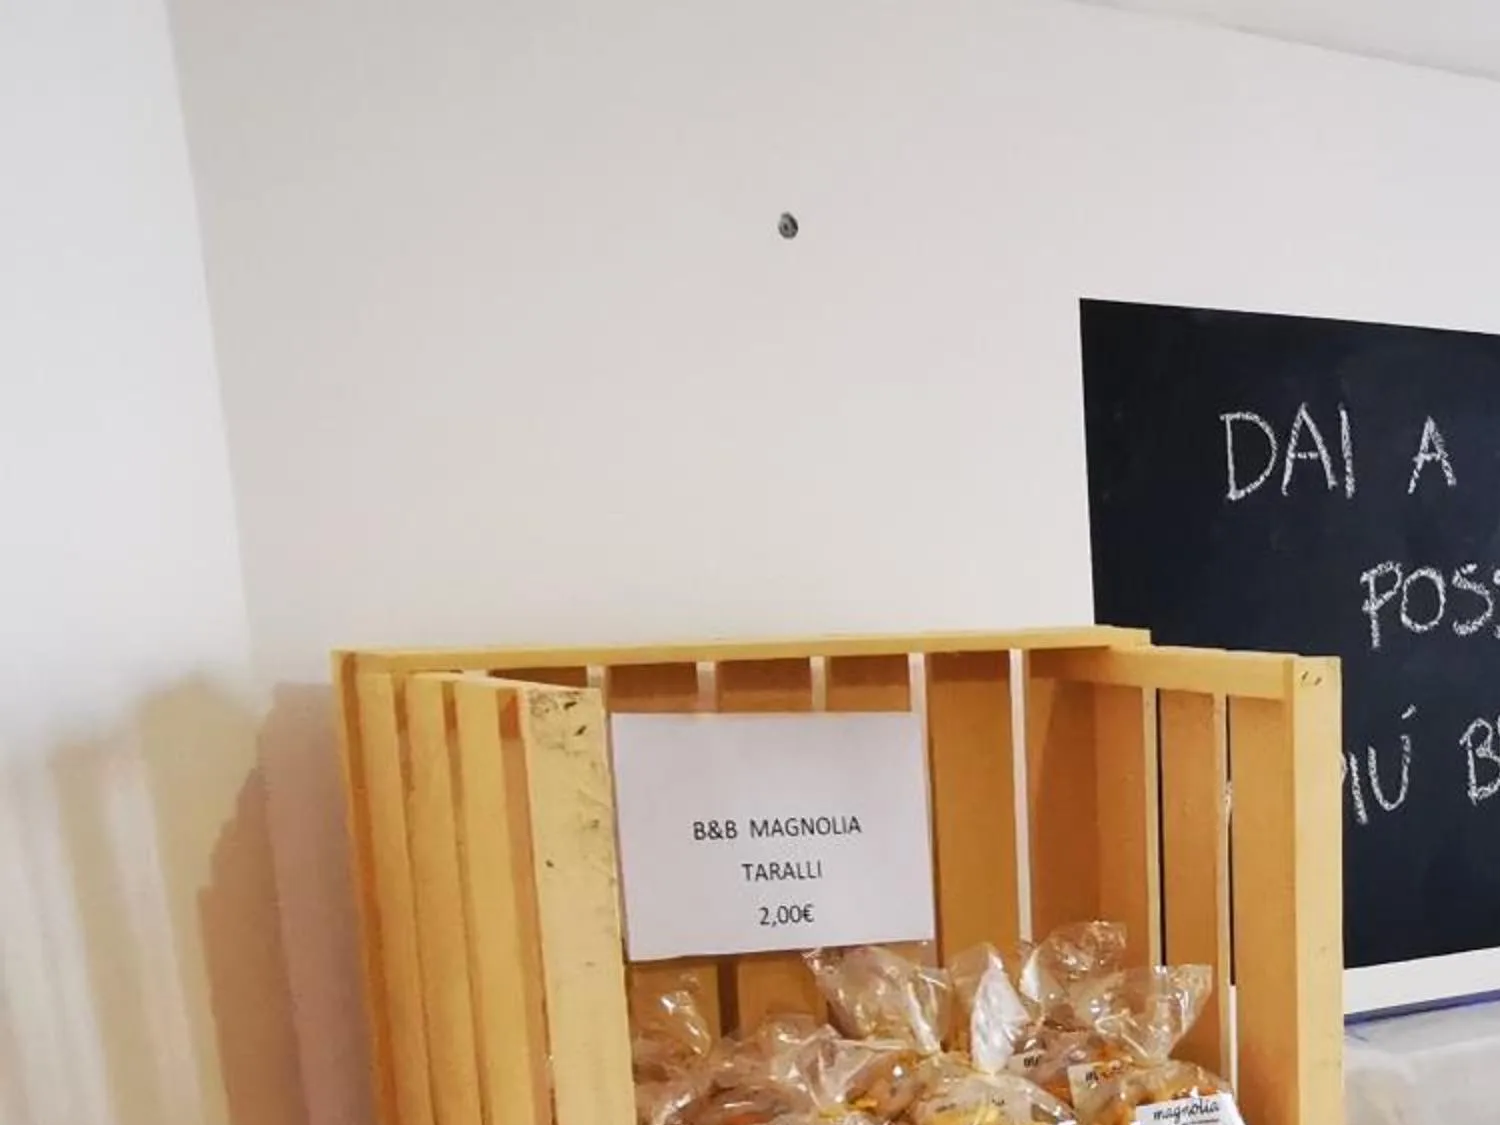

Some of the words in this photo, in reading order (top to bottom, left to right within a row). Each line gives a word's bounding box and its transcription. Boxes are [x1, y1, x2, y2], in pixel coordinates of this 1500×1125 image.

[1220, 401, 1356, 501] DAI
[1407, 416, 1457, 494] A
[692, 819, 738, 841] B&B
[749, 815, 862, 839] MAGNOLIA
[741, 860, 823, 882] TARALLI
[759, 903, 815, 928] 2,00€
